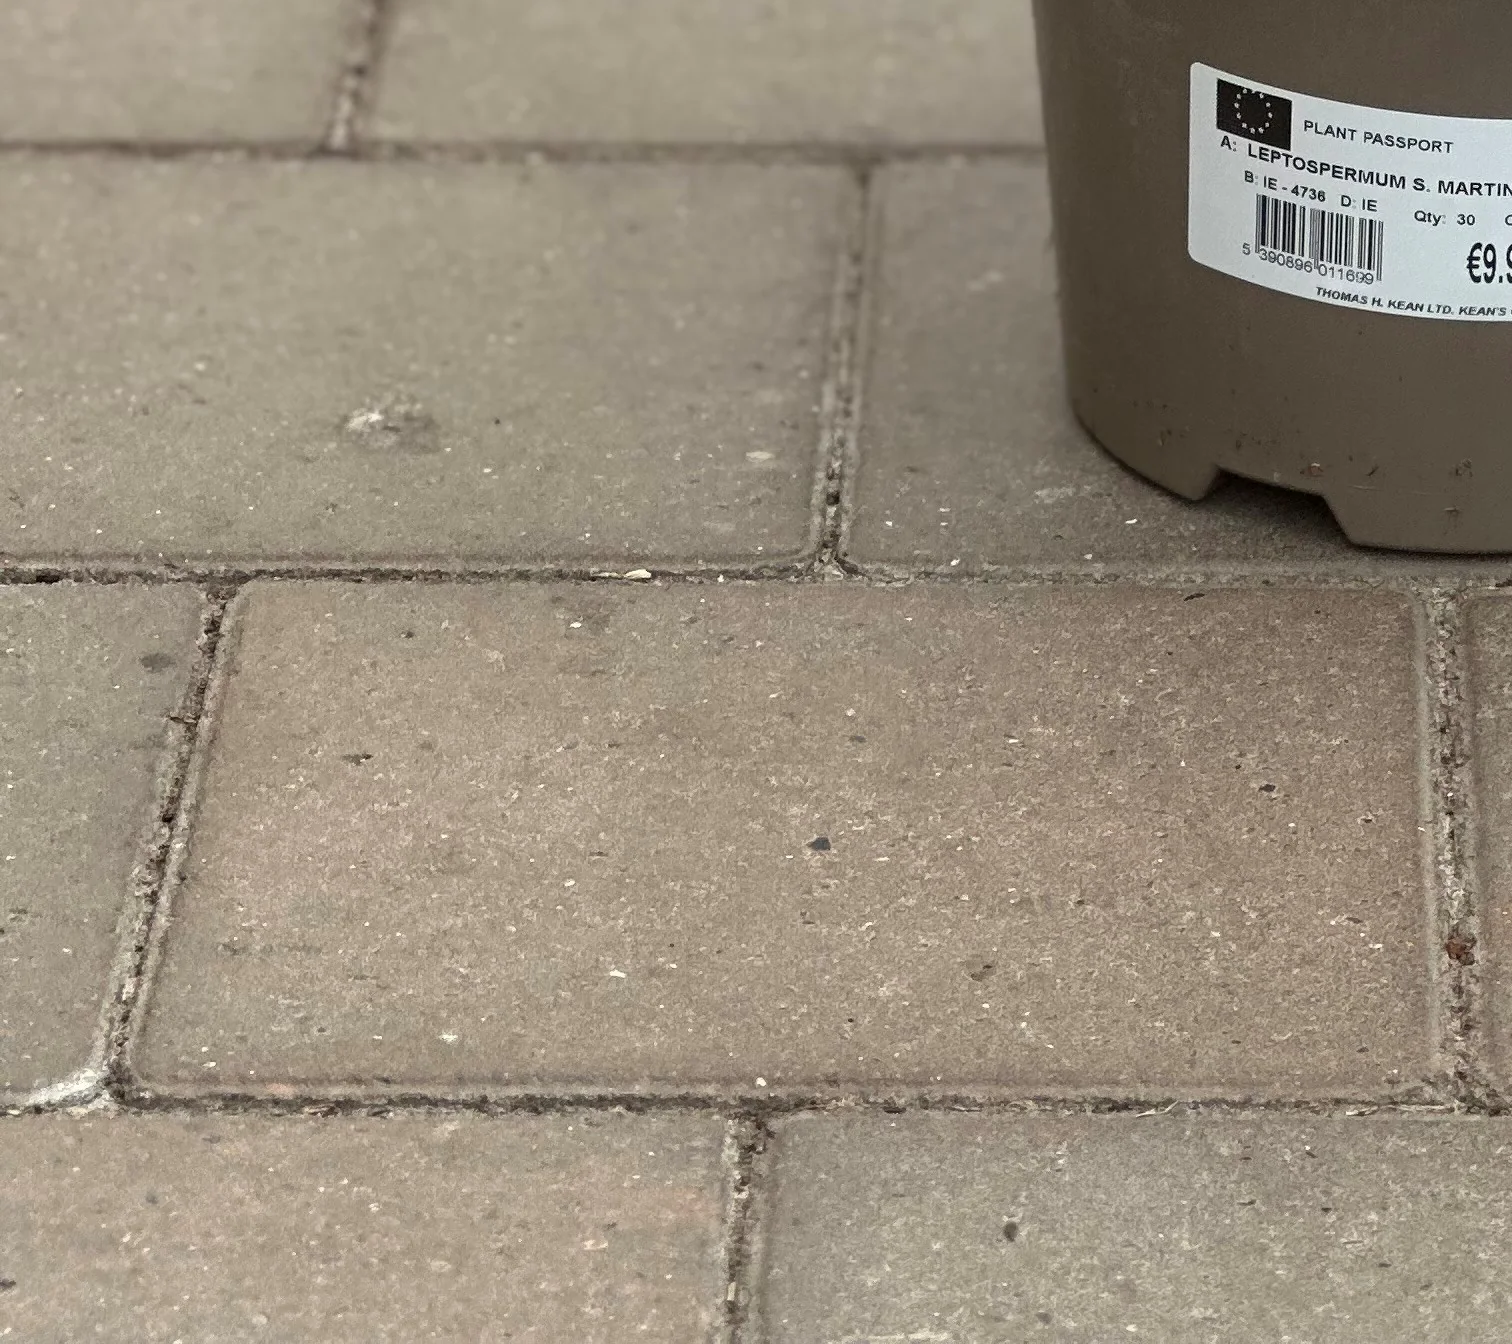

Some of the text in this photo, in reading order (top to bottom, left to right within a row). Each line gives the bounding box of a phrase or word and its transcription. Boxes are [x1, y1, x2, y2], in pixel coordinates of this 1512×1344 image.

[1304, 119, 1454, 154] PLANT PASSPORT
[1220, 135, 1237, 152] A:
[1248, 143, 1406, 190] LEPTOSPERMUM
[1412, 177, 1431, 193] S.
[1244, 170, 1259, 186] B:
[1263, 175, 1278, 191] IE
[1291, 184, 1327, 203] 4736
[1340, 194, 1357, 209] D:
[1362, 198, 1378, 212] IE
[1414, 210, 1447, 226] Qty:
[1456, 213, 1476, 226] 30
[1242, 242, 1375, 285] 5 390896 011699
[1316, 286, 1368, 305] THOMAS
[1371, 297, 1384, 308] H.
[1388, 299, 1424, 313] KEAN
[1427, 303, 1454, 315] LTD.
[1458, 305, 1507, 317] KEAN'S
